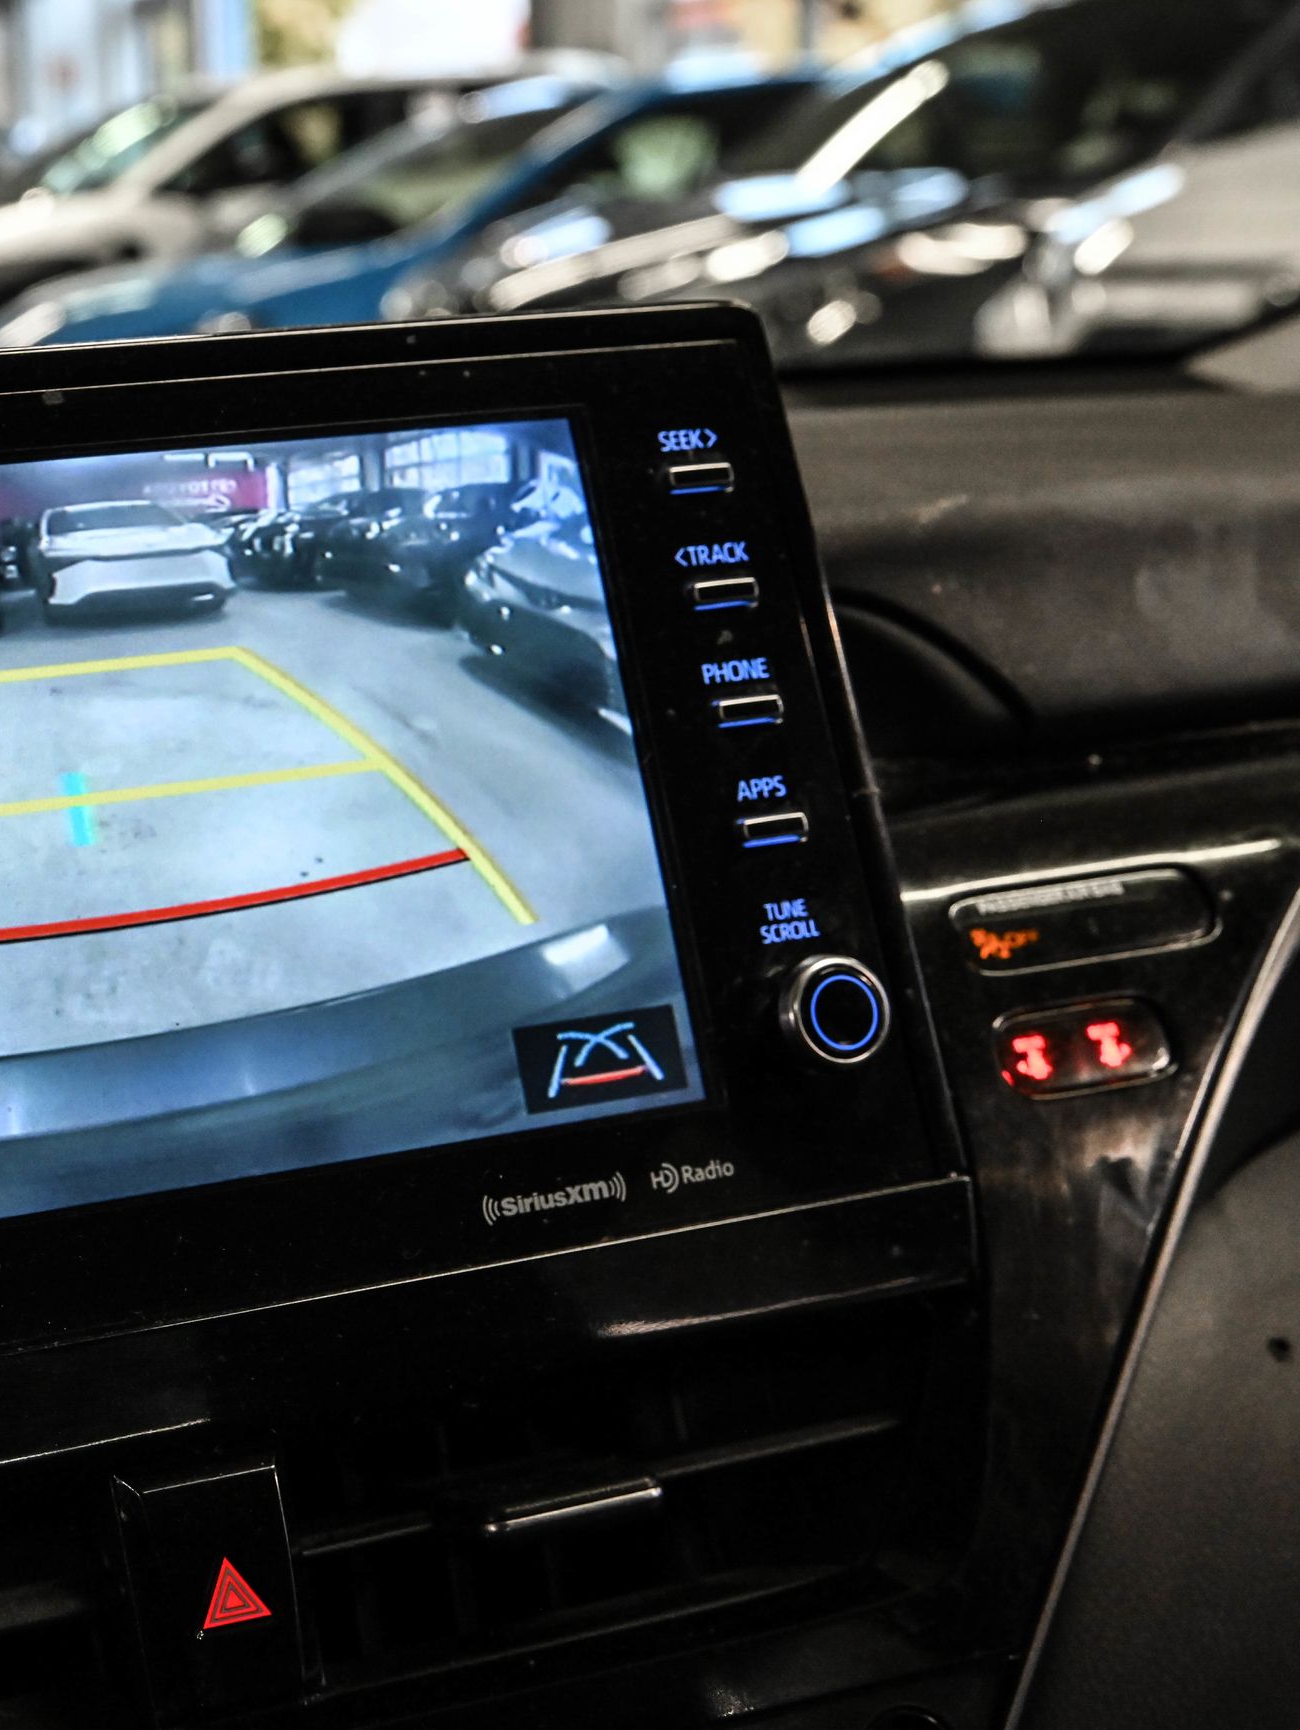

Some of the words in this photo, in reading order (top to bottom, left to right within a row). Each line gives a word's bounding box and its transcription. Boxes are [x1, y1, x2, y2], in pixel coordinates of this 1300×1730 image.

[700, 656, 771, 685] PHONE
[737, 775, 787, 802] APPS
[763, 898, 808, 922] TUNE
[760, 919, 820, 945] SCROLL
[681, 1160, 734, 1184] Radio
